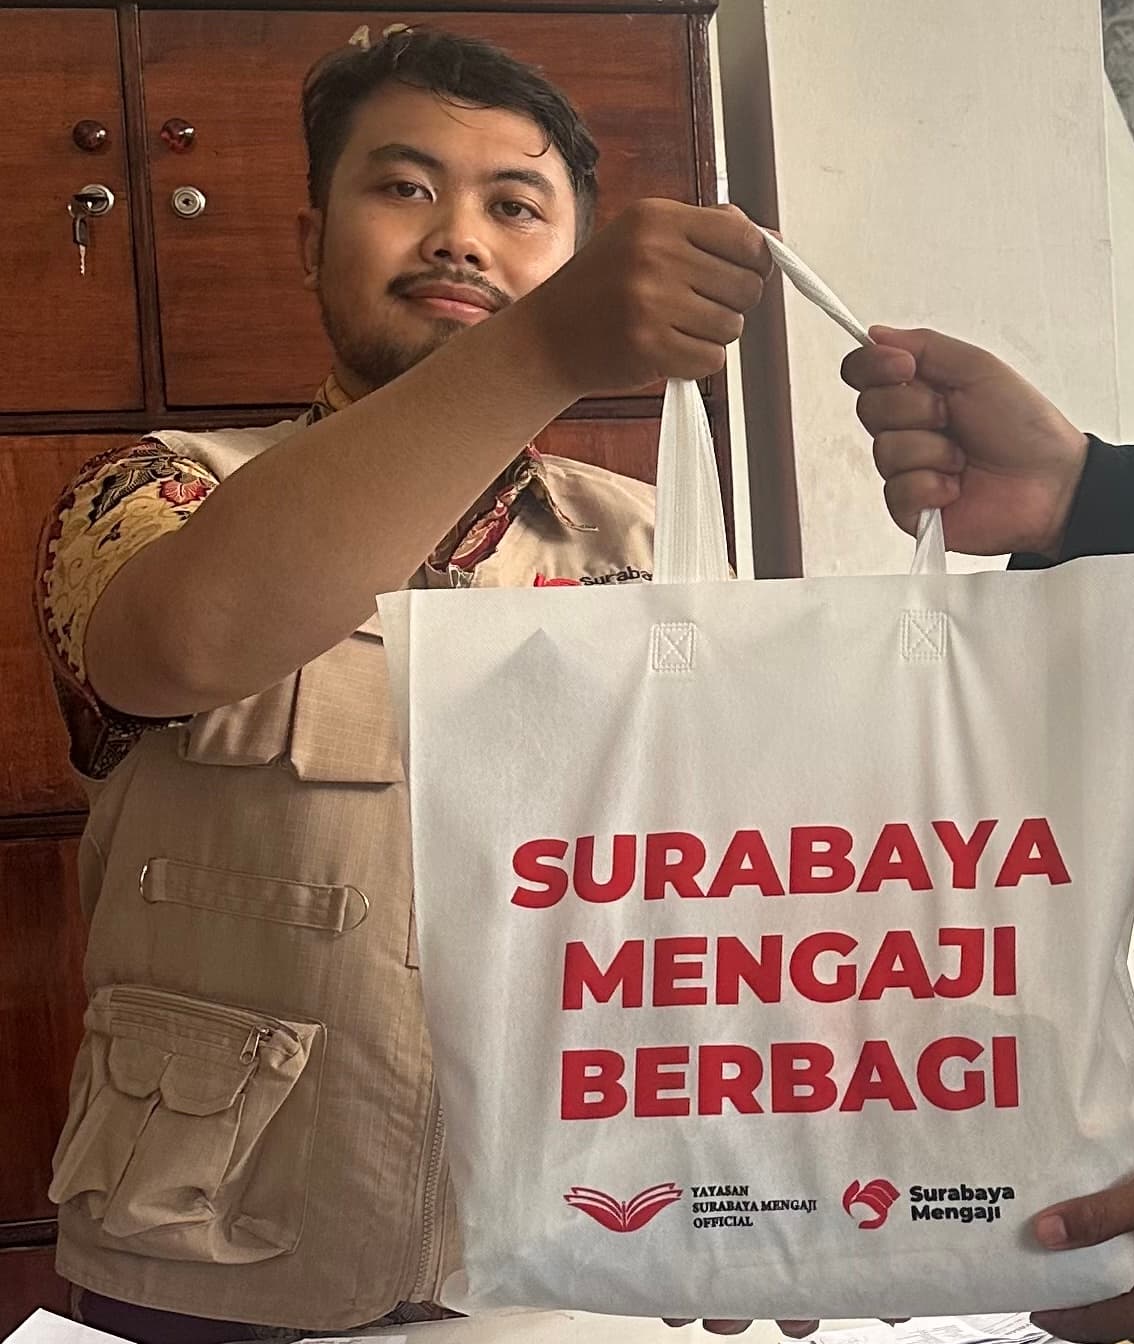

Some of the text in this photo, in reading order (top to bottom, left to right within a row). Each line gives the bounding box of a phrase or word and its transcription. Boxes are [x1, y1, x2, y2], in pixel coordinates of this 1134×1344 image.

[580, 565, 654, 586] Suraba
[510, 817, 1073, 910] SURABAYA
[561, 925, 1017, 1011] MENGAJI
[560, 1036, 1020, 1121] BERBAGI
[690, 1185, 750, 1199] YAYASAN
[909, 1183, 1016, 1204] Surabaya
[691, 1198, 818, 1214] SURABAYA MENGAJI
[910, 1203, 1001, 1223] Mengaji
[692, 1215, 755, 1230] OFFICIAL
